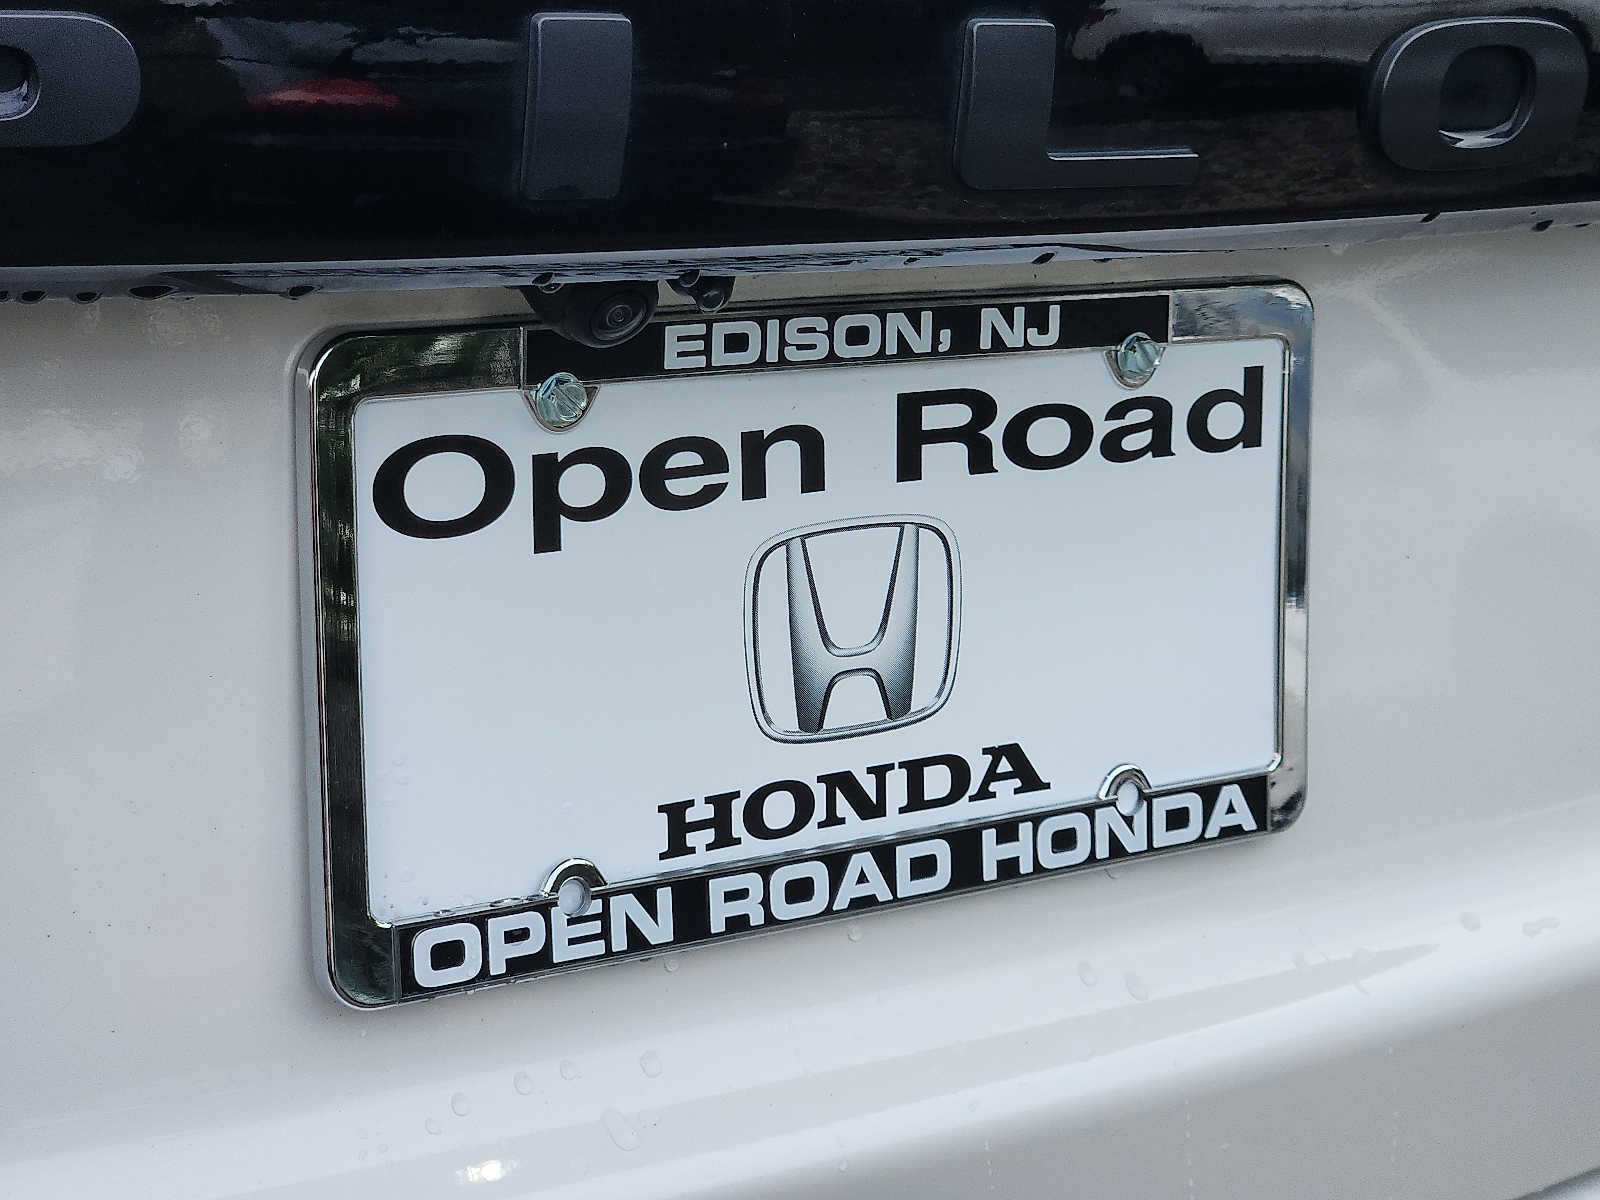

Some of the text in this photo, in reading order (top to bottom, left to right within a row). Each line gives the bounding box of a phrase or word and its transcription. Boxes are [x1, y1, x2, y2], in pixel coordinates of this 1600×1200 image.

[663, 304, 1061, 371] EDISON, NJ
[372, 365, 1265, 555] Open Road
[656, 742, 1051, 862] HONDA
[412, 783, 1259, 989] OPEN ROAD HONDA
